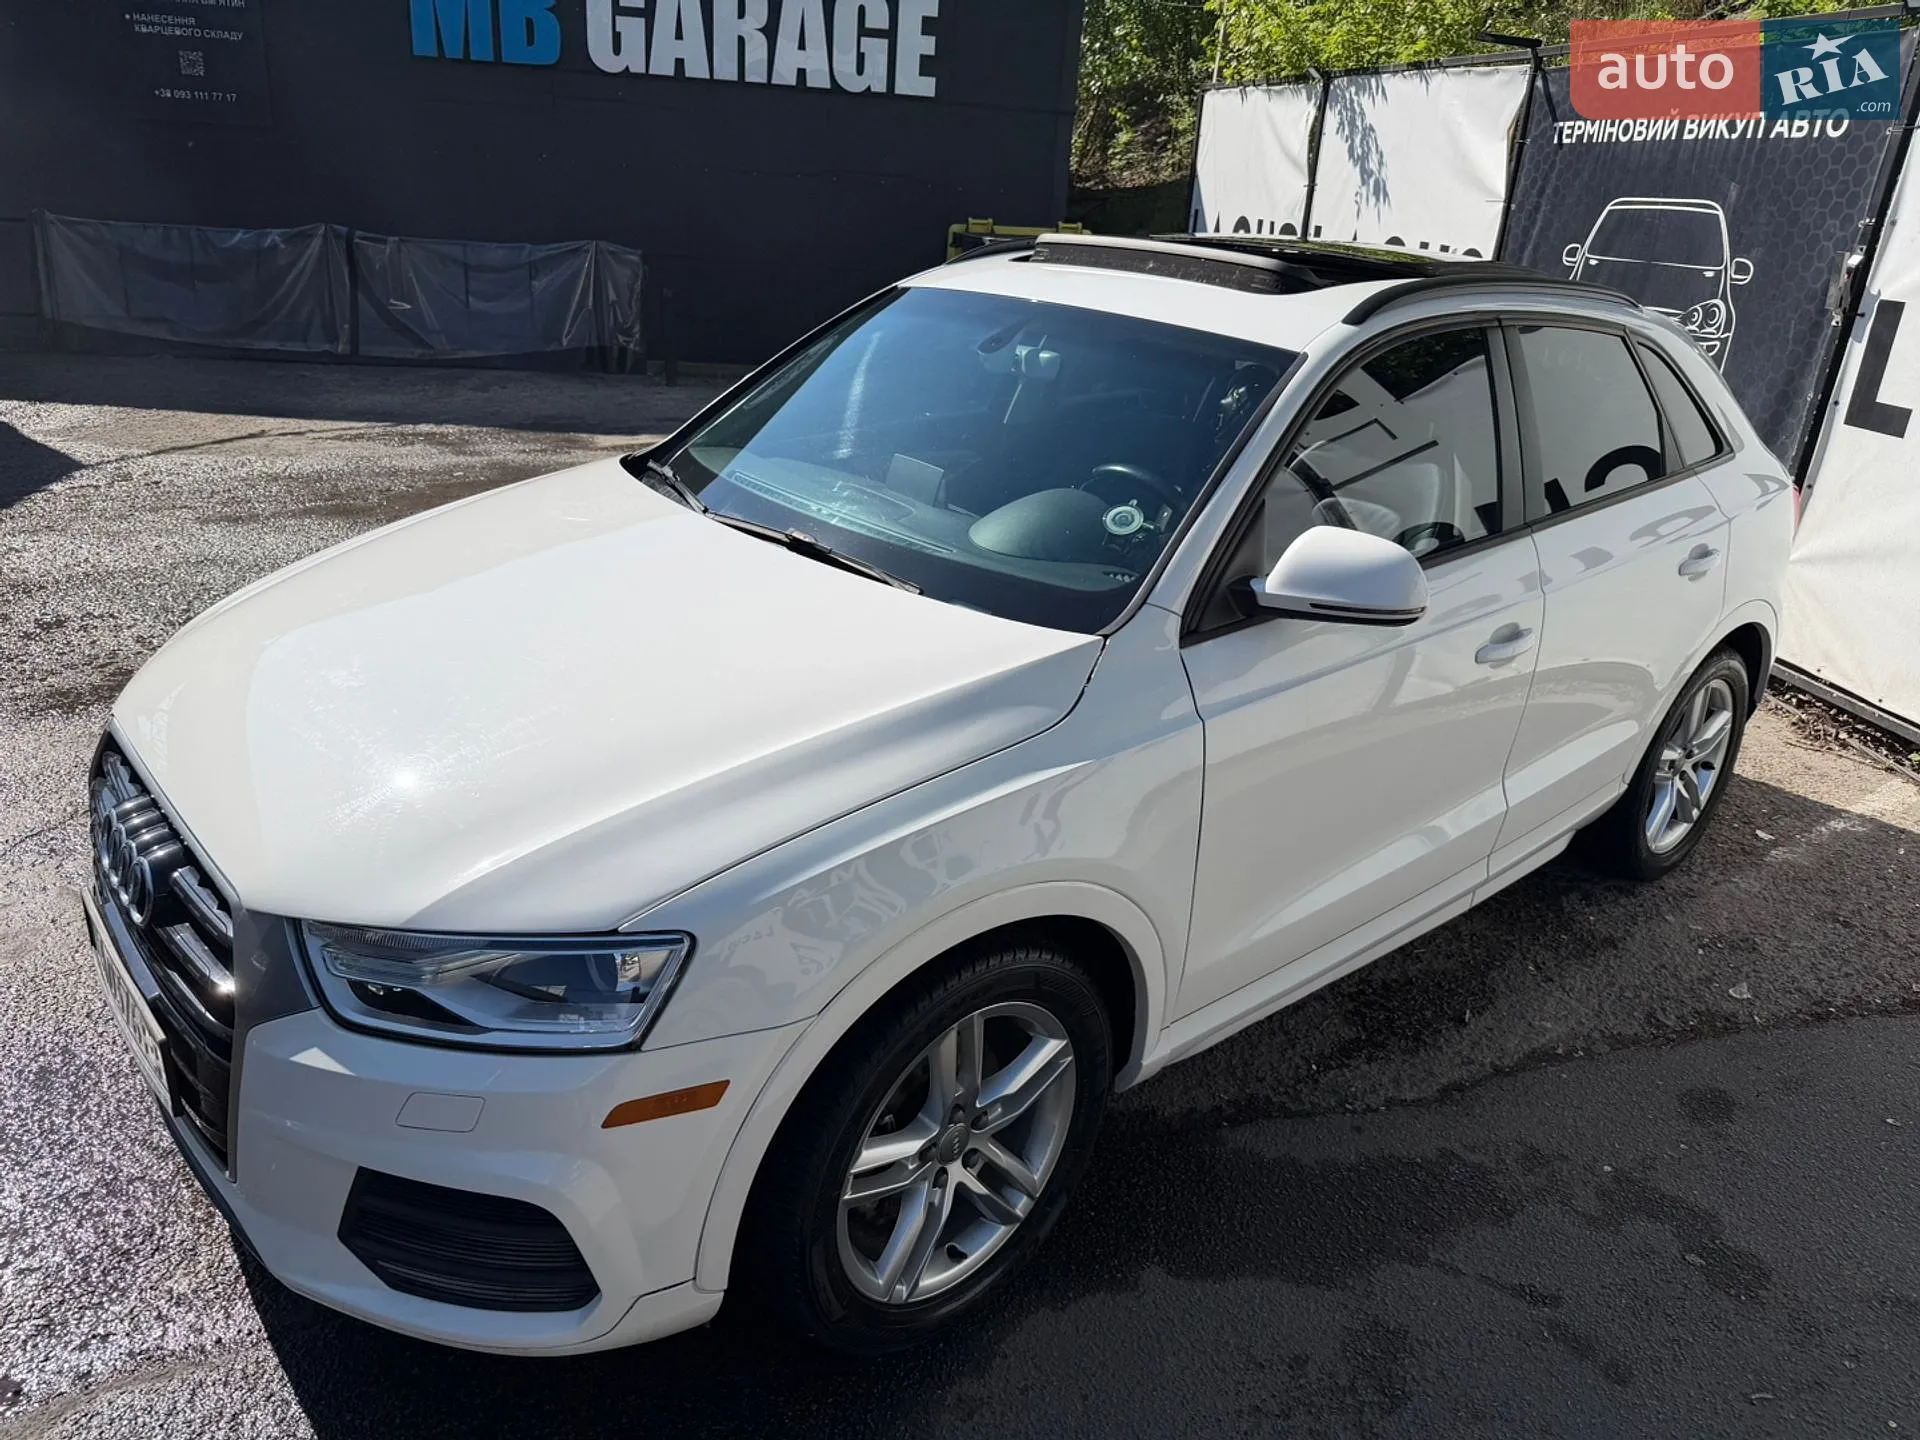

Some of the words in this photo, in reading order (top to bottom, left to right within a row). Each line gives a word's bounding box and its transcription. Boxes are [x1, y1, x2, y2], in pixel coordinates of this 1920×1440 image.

[132, 12, 196, 25] НАНЕСЕННЯ
[134, 24, 201, 37] КВАРЦЕВОГО
[203, 29, 243, 40] СКЛАДУ
[586, 0, 938, 97] GARAGE
[173, 89, 191, 99] 093
[194, 91, 208, 100] 111
[211, 92, 223, 101] 77
[226, 93, 237, 102] 17
[1552, 108, 1680, 144] ТЕРМІНОВИЙ
[1682, 112, 1766, 141] ВИКУП
[1769, 108, 1850, 139] АВТО
